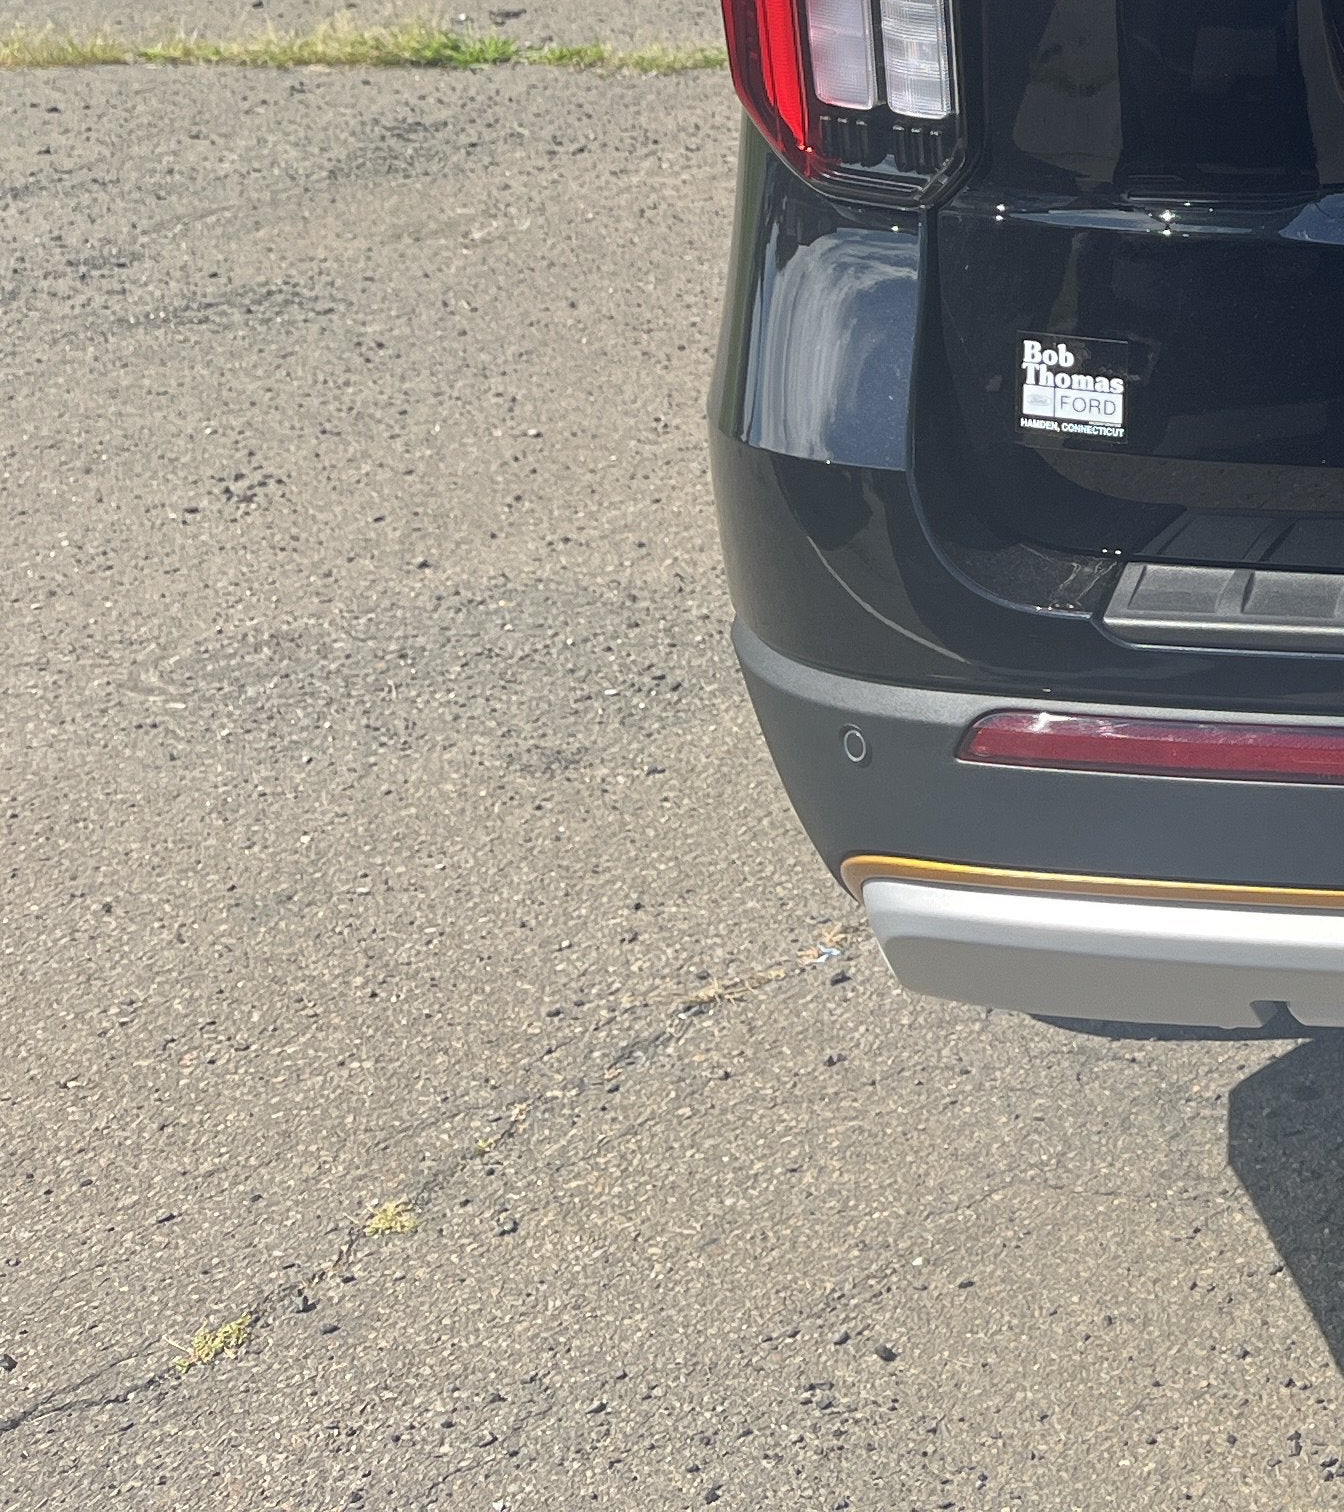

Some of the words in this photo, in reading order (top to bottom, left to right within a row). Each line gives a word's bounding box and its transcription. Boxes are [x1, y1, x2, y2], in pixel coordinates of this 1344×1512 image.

[1022, 339, 1075, 368] Bob
[1021, 362, 1125, 394] Thomas
[1060, 394, 1117, 416] FORD
[1020, 417, 1061, 433] HAMDEN,
[1061, 422, 1126, 437] CONNECTICUT
